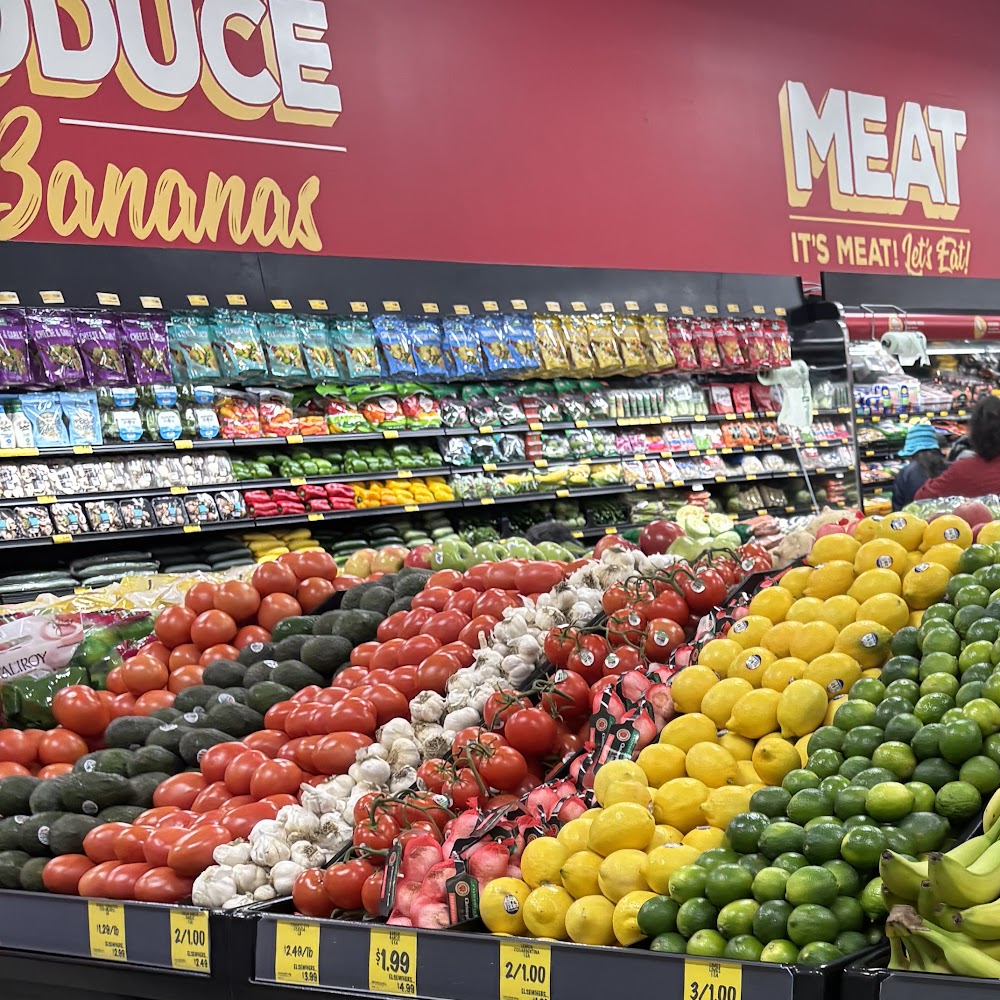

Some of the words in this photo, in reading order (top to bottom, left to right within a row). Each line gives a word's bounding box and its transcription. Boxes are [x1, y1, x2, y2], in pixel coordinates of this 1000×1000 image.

[778, 80, 967, 220] MEAT
[791, 232, 830, 264] IT'S
[836, 234, 899, 267] MEAT!
[901, 233, 932, 276] Let's
[936, 236, 971, 274] Eat!
[175, 928, 205, 946] 2/1.00
[376, 948, 409, 974] $1.99
[505, 961, 546, 984] 2/1.00
